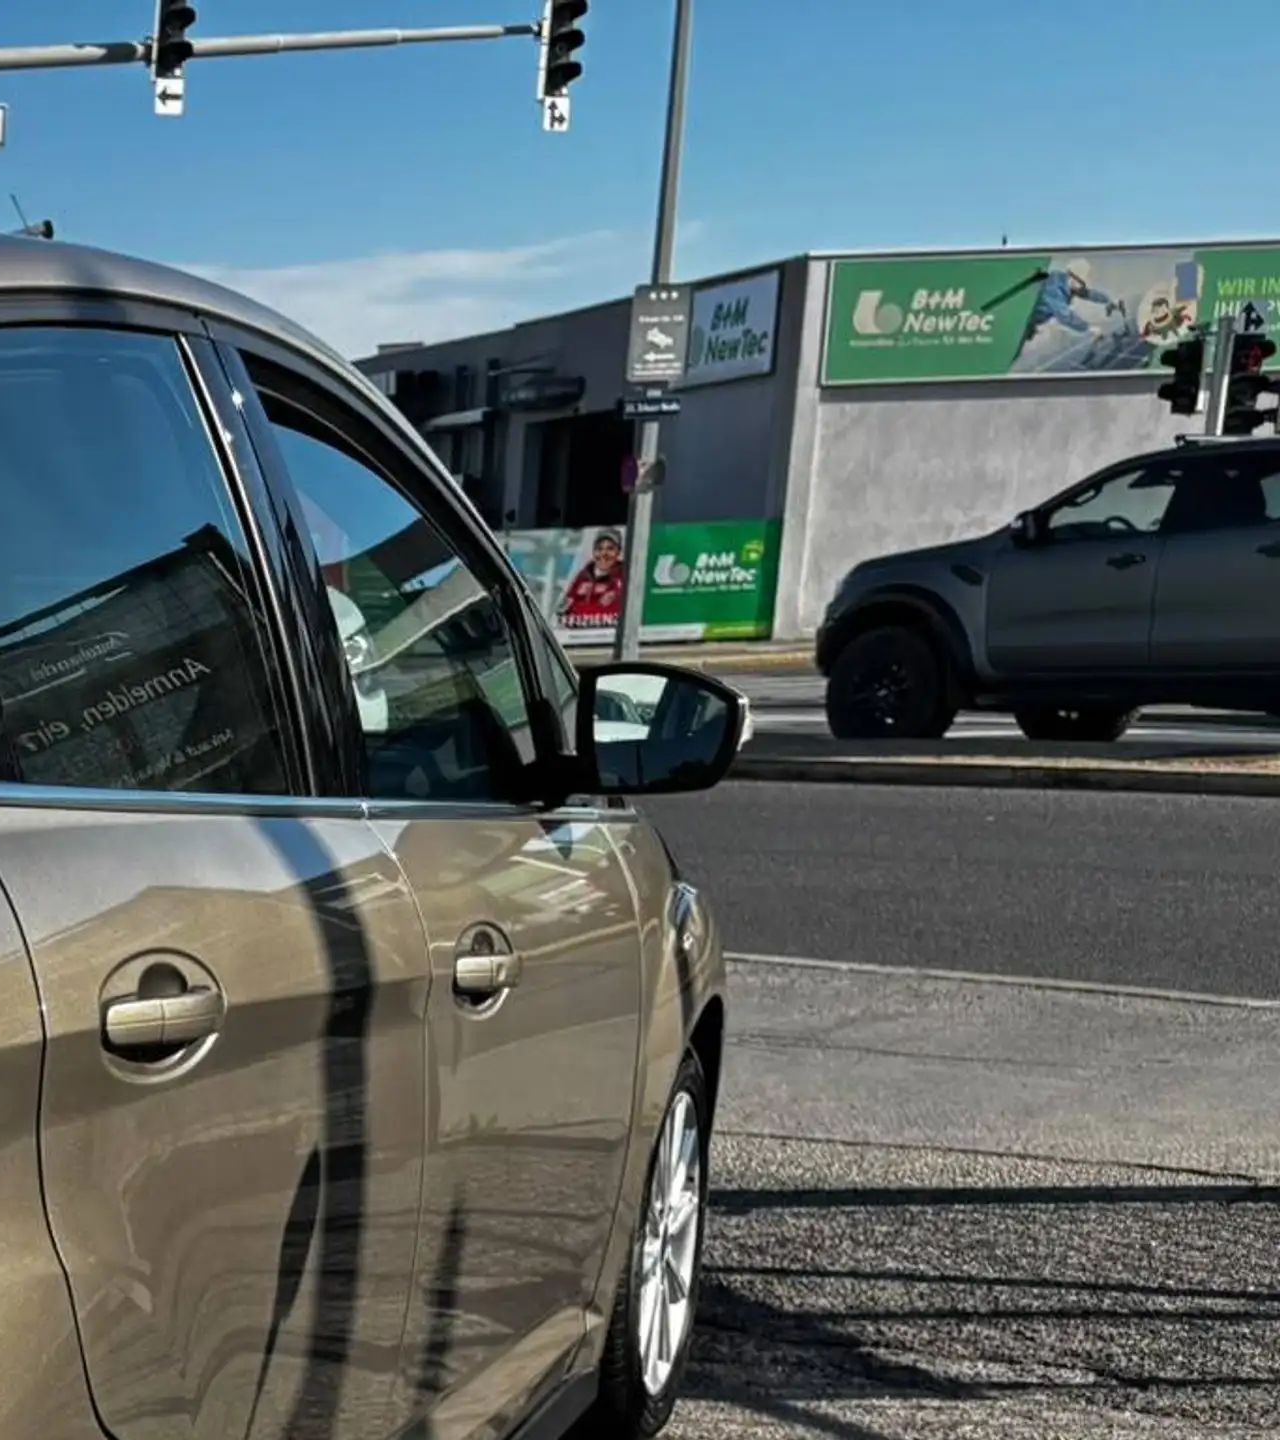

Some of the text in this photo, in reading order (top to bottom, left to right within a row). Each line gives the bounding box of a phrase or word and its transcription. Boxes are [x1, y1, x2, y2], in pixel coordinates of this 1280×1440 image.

[910, 287, 966, 310] B+M
[903, 310, 995, 333] NewTec
[704, 328, 768, 364] NewTec
[690, 566, 757, 586] NewTec
